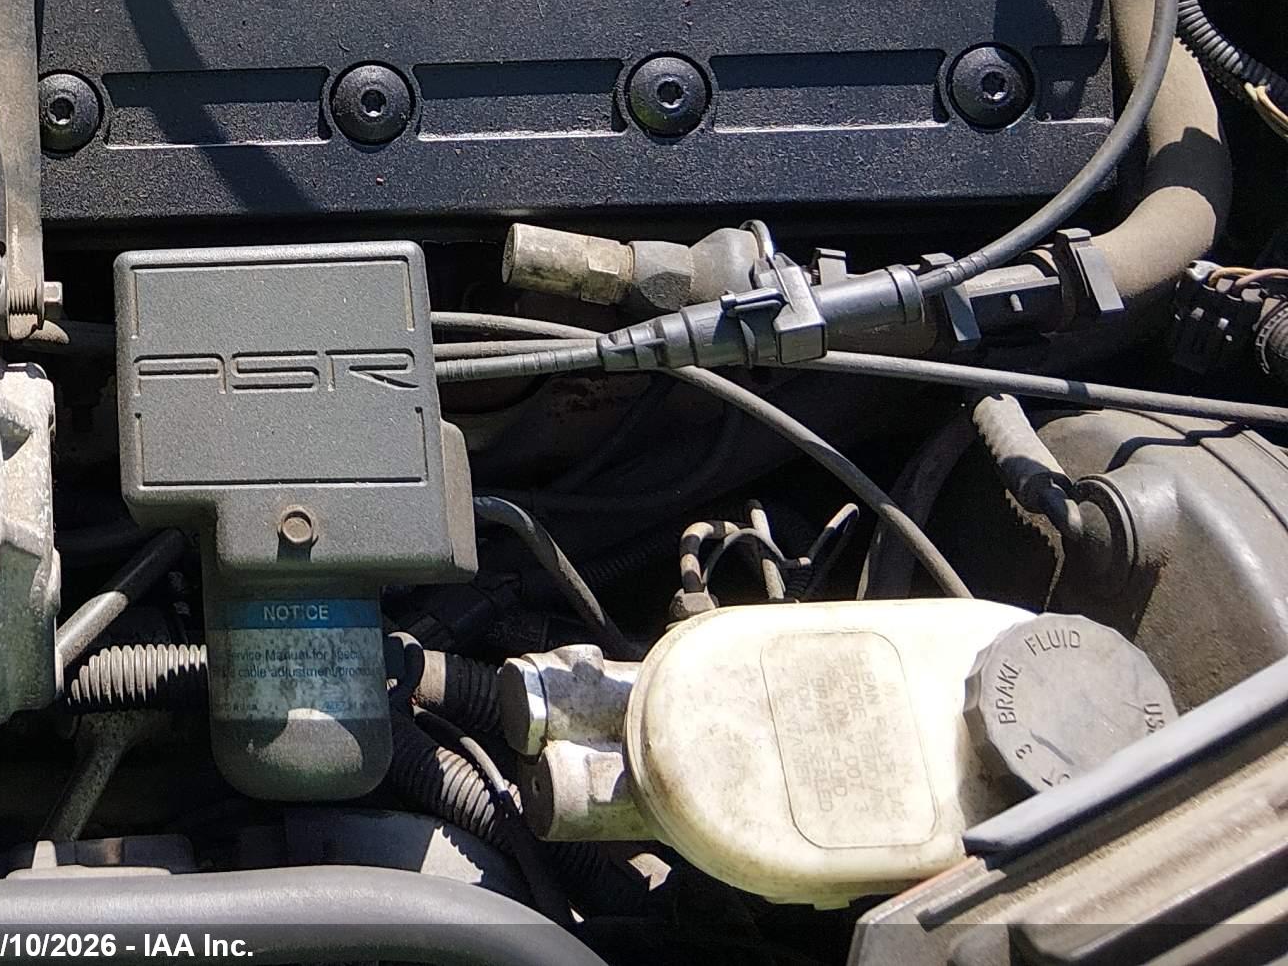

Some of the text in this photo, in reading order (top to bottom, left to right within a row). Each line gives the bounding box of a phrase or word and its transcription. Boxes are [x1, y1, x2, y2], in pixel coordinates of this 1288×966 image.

[133, 348, 420, 395] ASR
[270, 667, 335, 678] adjustment
[995, 629, 1081, 725] BRAKE FLUID
[811, 678, 834, 738] BRAKE
[1144, 702, 1165, 735] US
[808, 745, 833, 812] SEALED
[844, 756, 863, 791] DOT
[854, 802, 868, 813] 3
